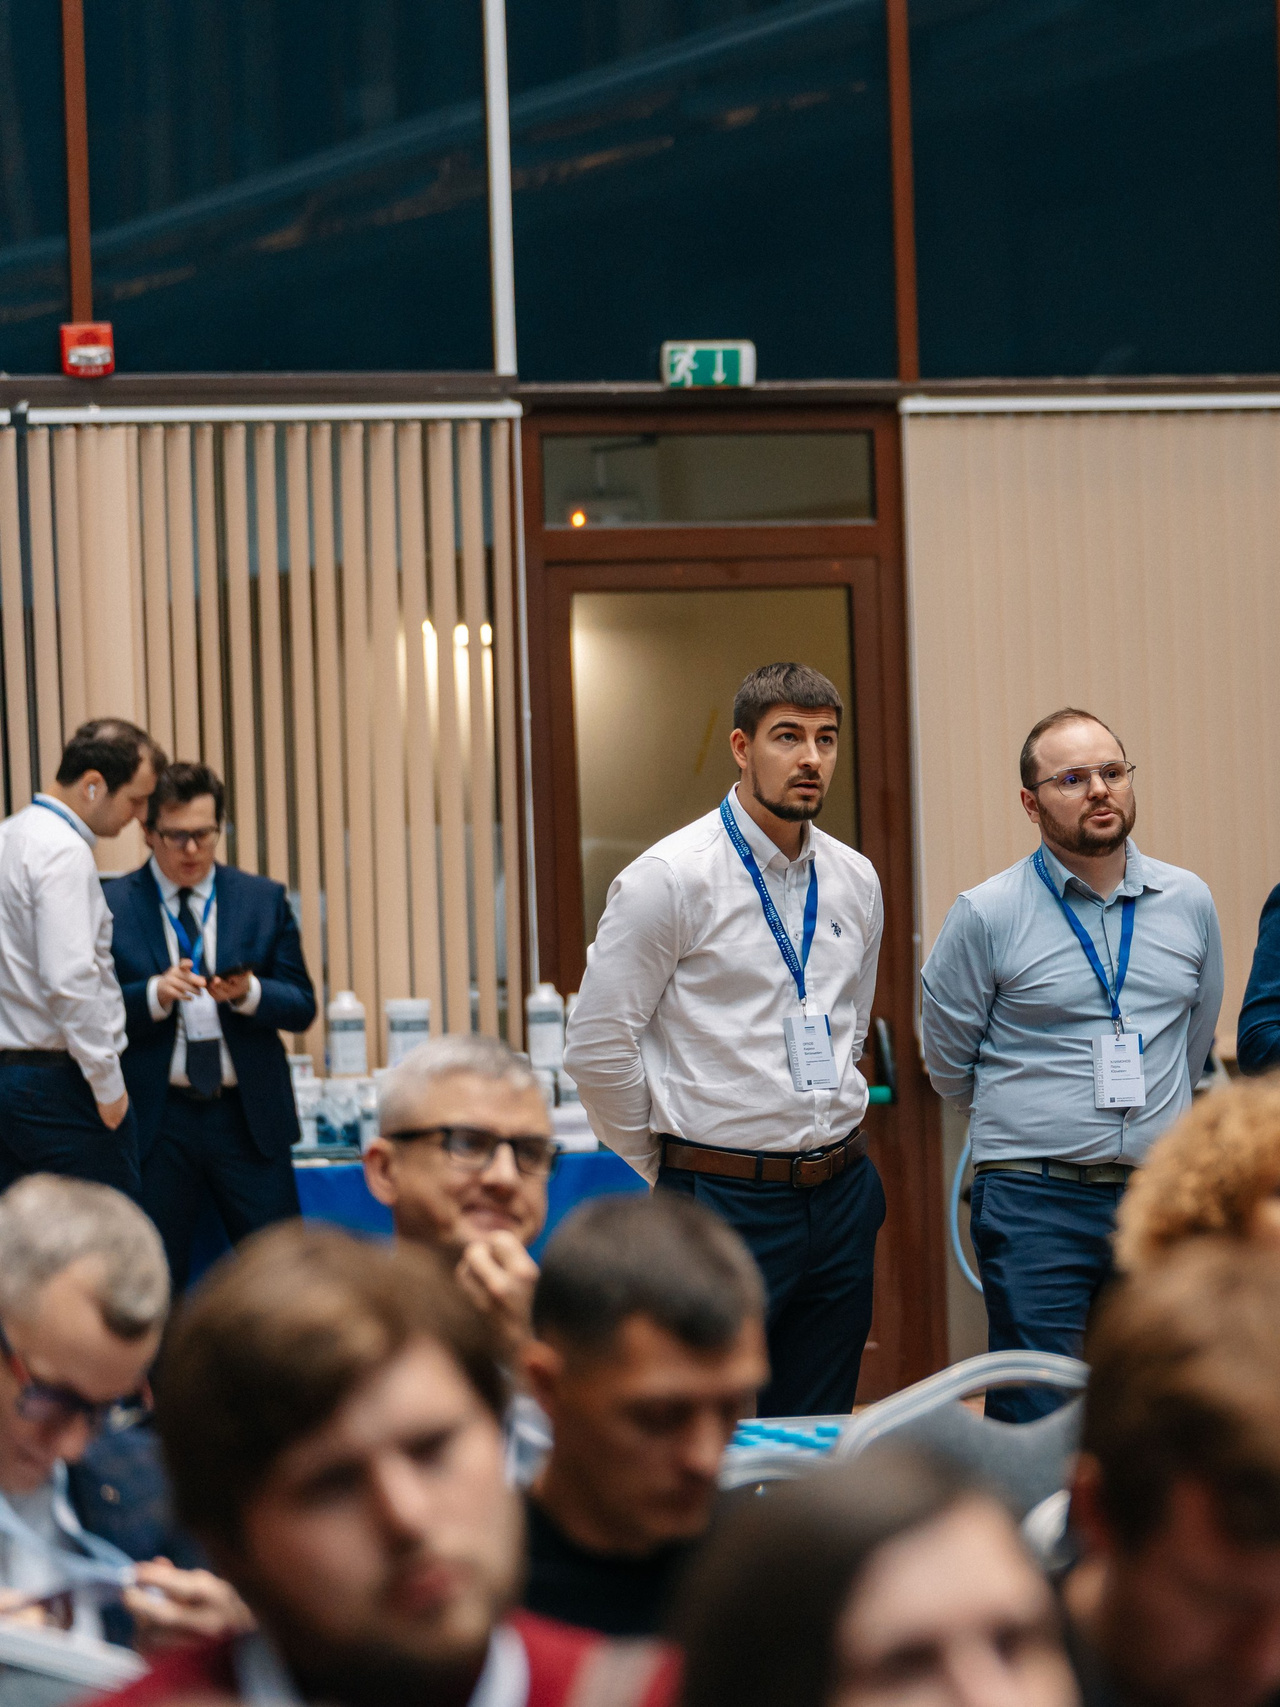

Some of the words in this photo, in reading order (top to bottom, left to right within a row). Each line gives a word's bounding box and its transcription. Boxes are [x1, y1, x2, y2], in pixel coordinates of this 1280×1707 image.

[731, 825, 751, 856] SYNERCON
[767, 902, 784, 935] СИНЕРКОН
[782, 938, 800, 971] SYNERCON
[790, 1040, 802, 1088] СИНЕРКОН
[1096, 1058, 1105, 1105] СИНЕРКОН
